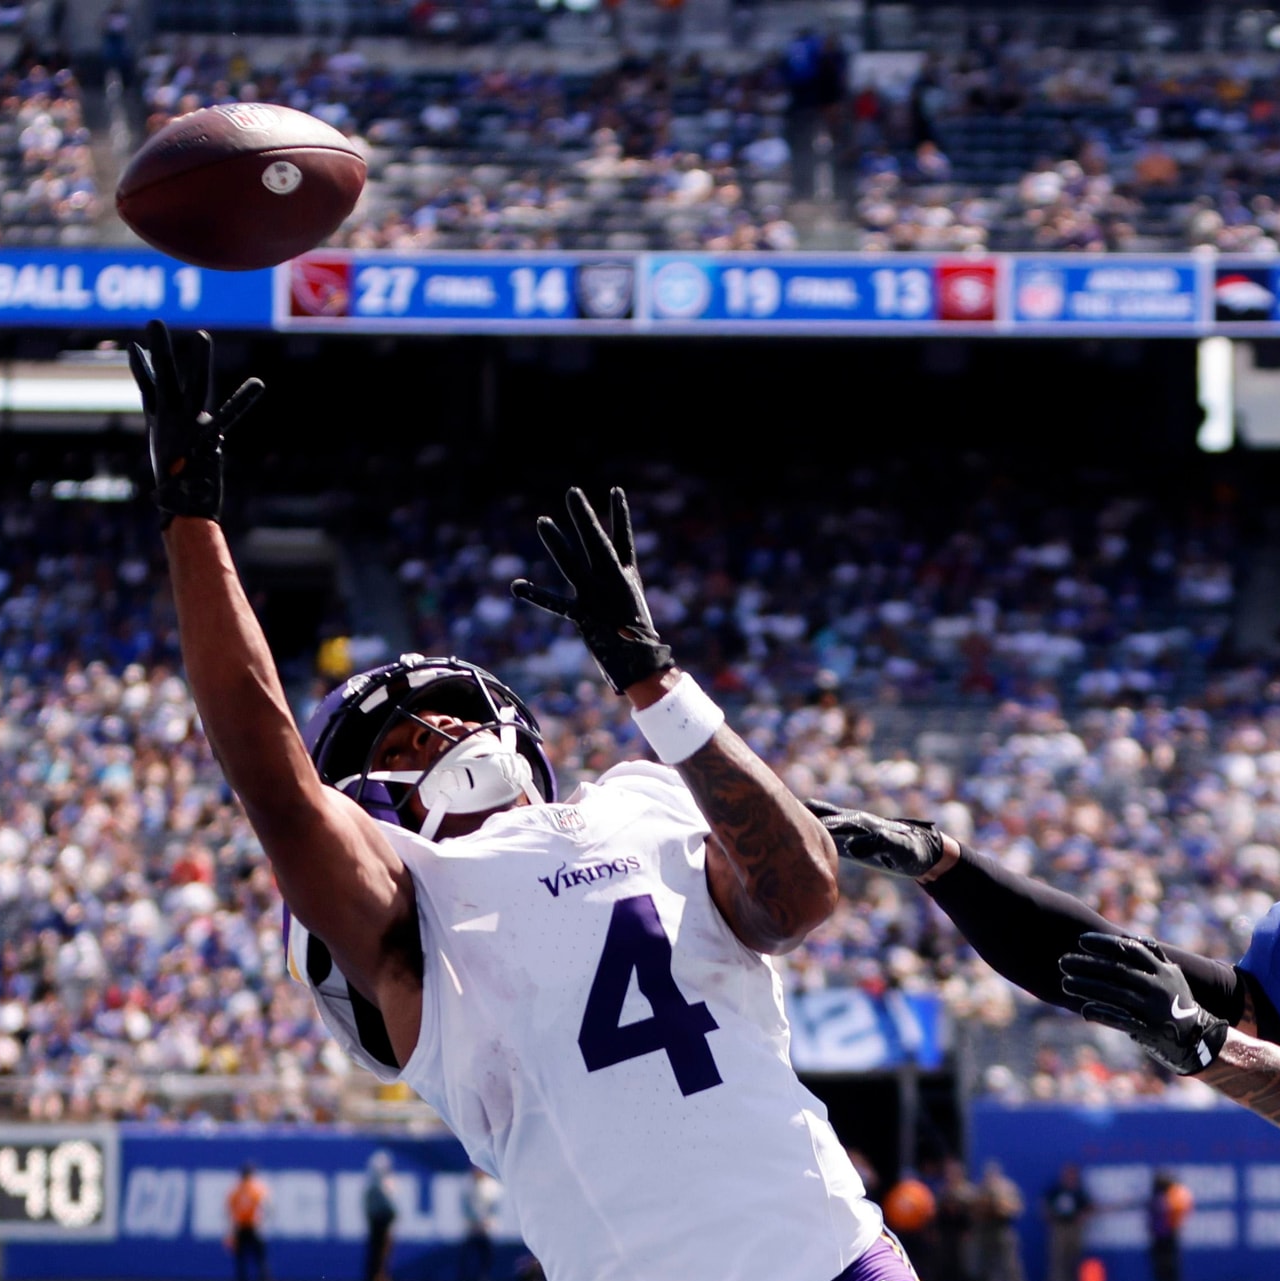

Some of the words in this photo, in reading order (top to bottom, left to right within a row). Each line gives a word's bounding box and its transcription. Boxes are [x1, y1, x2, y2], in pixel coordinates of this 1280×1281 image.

[95, 265, 166, 310] ON
[173, 267, 201, 311] 1
[356, 266, 418, 315] 27
[509, 267, 570, 315] 14
[722, 267, 781, 317] 19
[871, 268, 931, 317] 13
[578, 893, 724, 1097] 4
